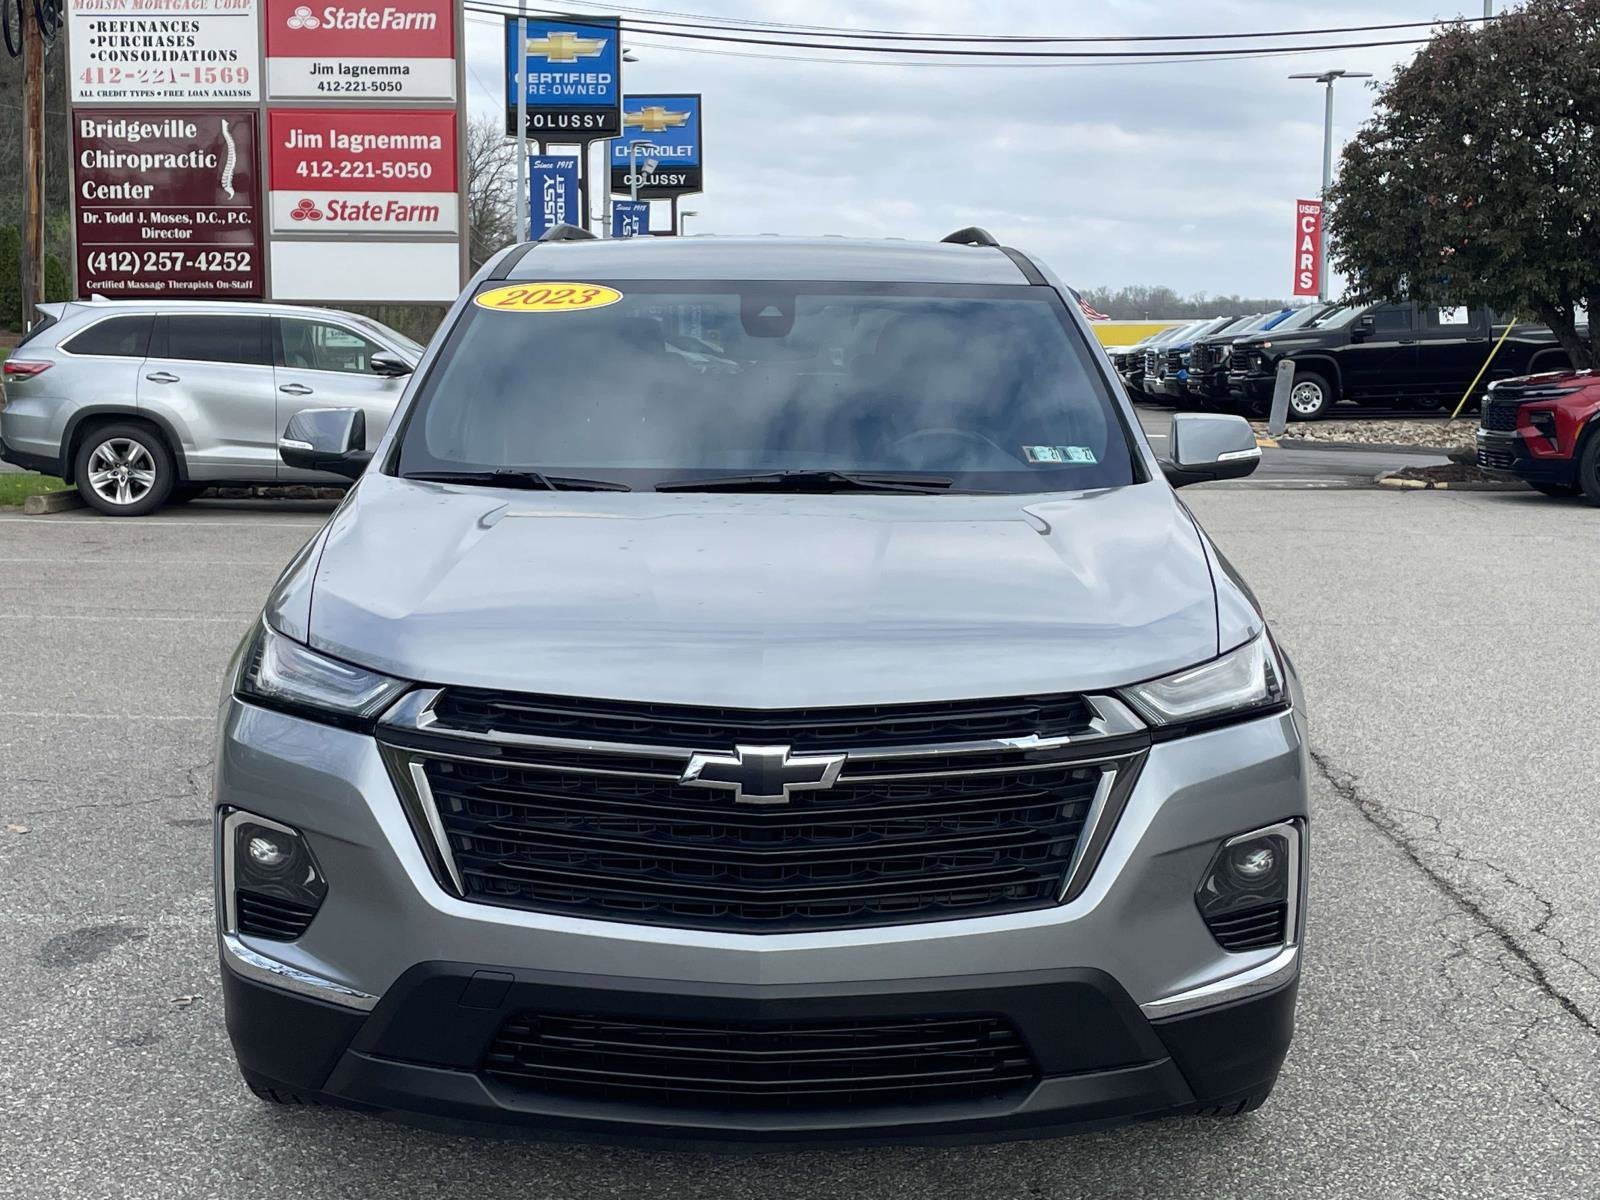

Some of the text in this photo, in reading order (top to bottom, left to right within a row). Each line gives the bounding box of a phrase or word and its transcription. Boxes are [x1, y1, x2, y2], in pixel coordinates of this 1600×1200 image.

[132, 0, 208, 10] MORTGAGE
[96, 20, 200, 33] REFINANCES
[97, 35, 196, 47] PURCHASES
[98, 50, 238, 62] CONSOLIDATIONS
[80, 66, 249, 84] 412-221-1569
[310, 63, 334, 75] Jim
[317, 81, 403, 92] 412-221-5050
[525, 84, 607, 95] RE-OWNED
[79, 89, 252, 97] ALL CREDIT TYPES FREE LOAN ANALYSIS
[80, 119, 197, 142] Bridgeville
[284, 129, 323, 148] Jim
[615, 145, 694, 157] CHEVROLET
[80, 150, 217, 172] Chiropractic
[533, 160, 553, 169] Since
[296, 161, 432, 179] 412-221-5050
[81, 180, 154, 199] Center
[1299, 205, 1320, 214] USED
[83, 212, 102, 224] Dr.
[103, 212, 134, 224] Todd
[137, 212, 148, 224] J.
[150, 212, 193, 225] Moses,
[141, 227, 193, 239] Director
[1299, 216, 1316, 289] CARS
[86, 280, 253, 290] Certified Massage Therapists On-Staff
[496, 288, 601, 306] 2023
